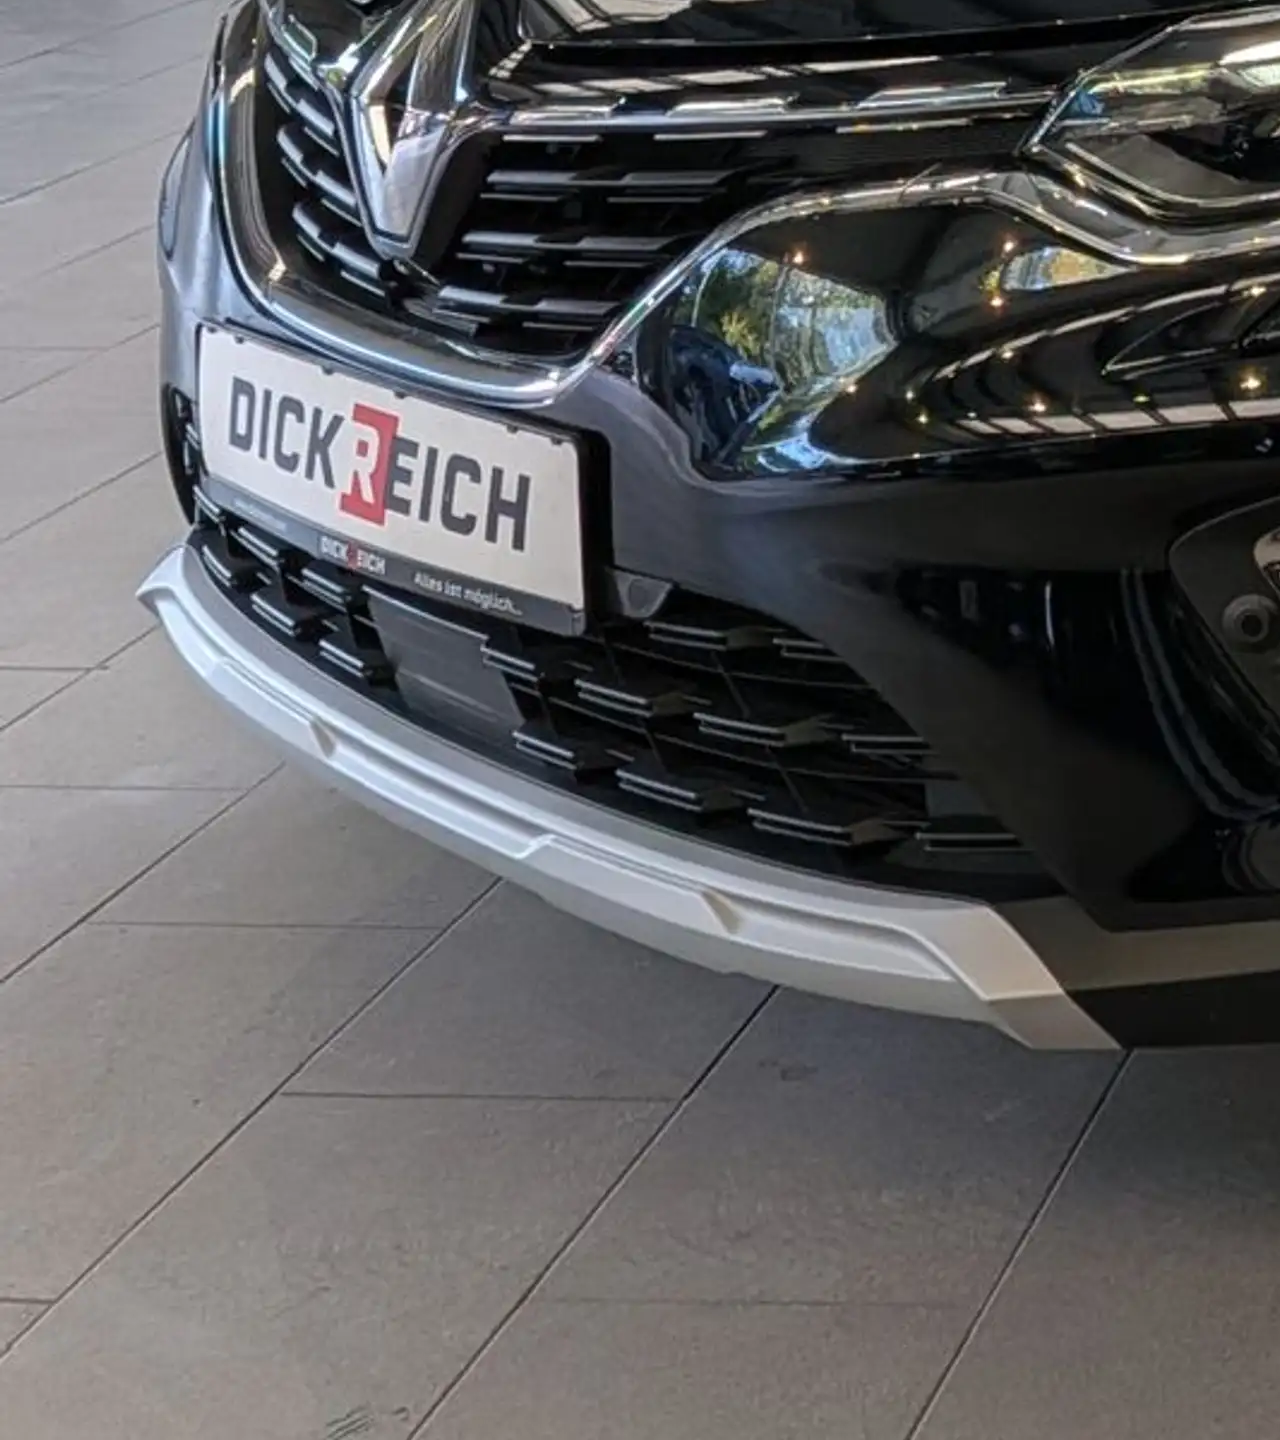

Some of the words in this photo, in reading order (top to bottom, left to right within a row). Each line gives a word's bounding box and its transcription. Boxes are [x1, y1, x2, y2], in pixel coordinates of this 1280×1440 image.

[228, 376, 531, 552] DICKREICH
[413, 570, 443, 593] Alles
[444, 578, 463, 599] ist
